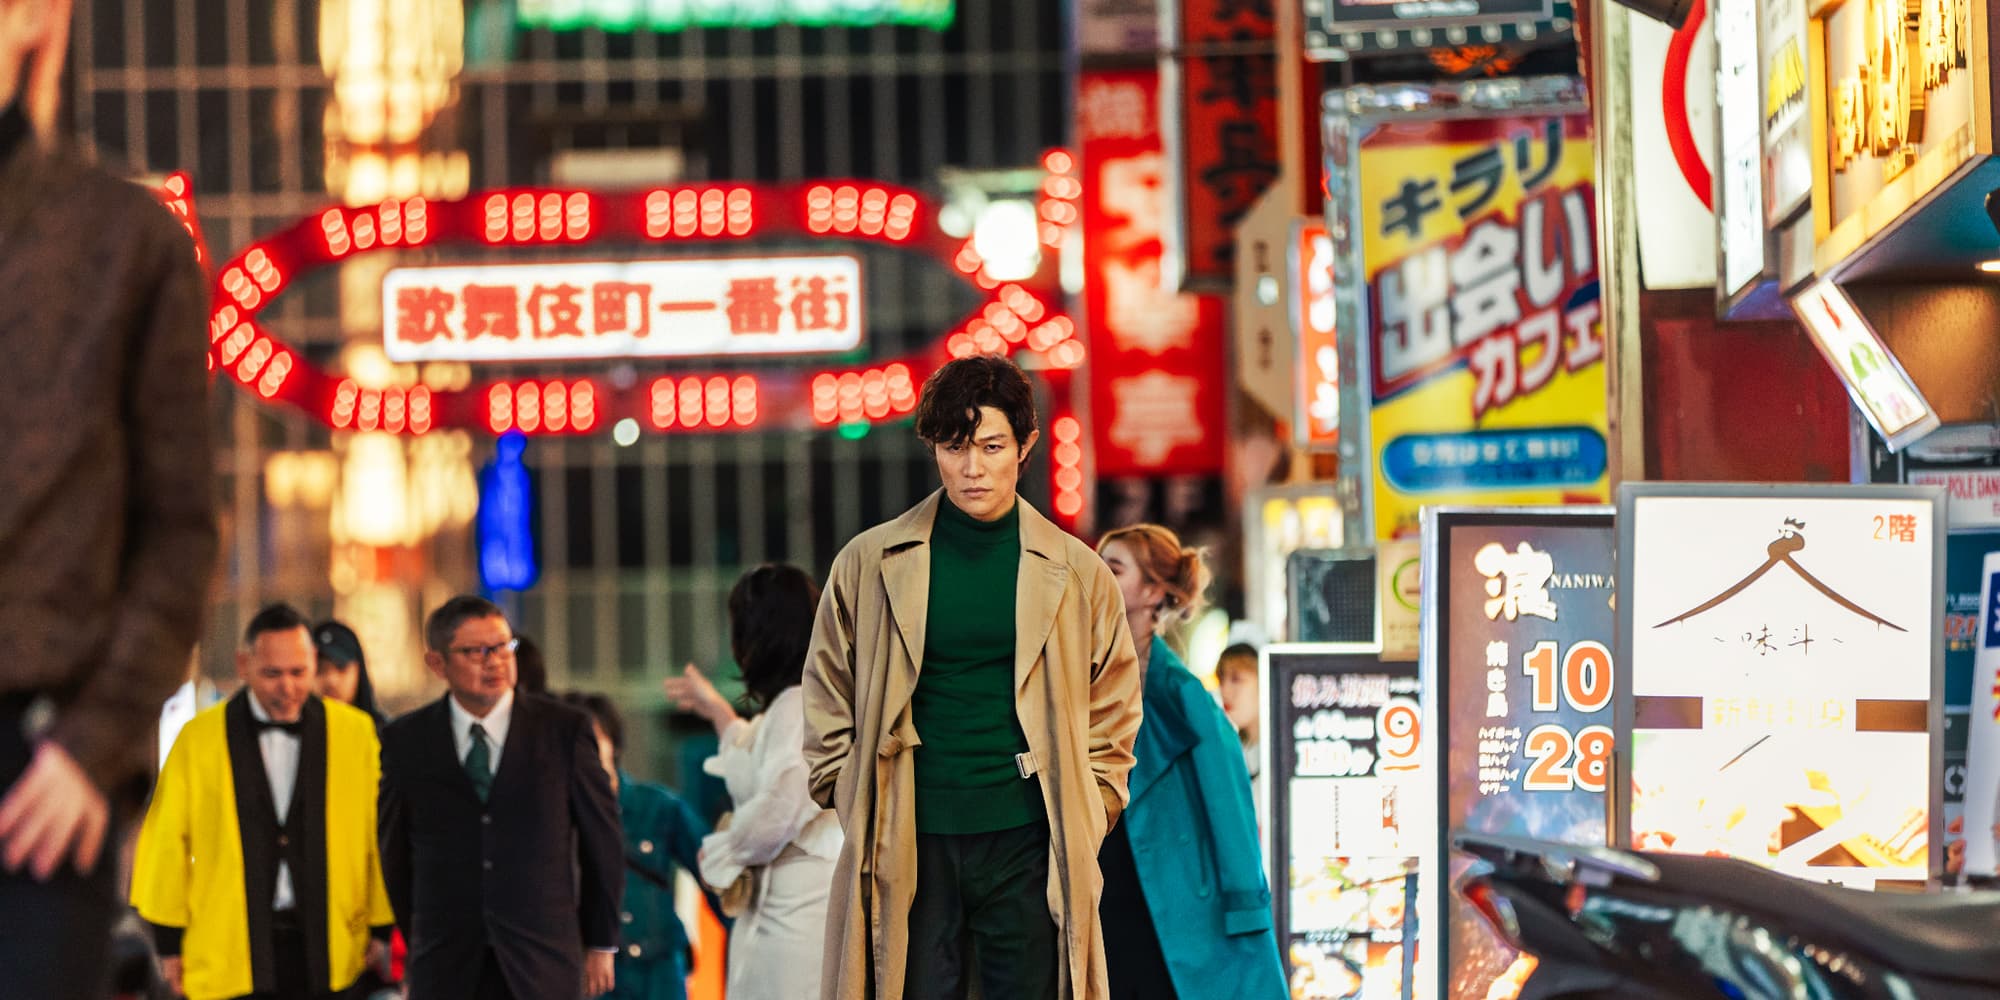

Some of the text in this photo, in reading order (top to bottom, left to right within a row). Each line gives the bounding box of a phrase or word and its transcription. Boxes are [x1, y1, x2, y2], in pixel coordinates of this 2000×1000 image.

[1382, 115, 1563, 236] キラリ
[396, 275, 848, 342] 歌舞伎町一番街
[1380, 191, 1592, 382] 出会い
[1475, 303, 1602, 412] カフェ
[1873, 514, 1917, 543] 2階
